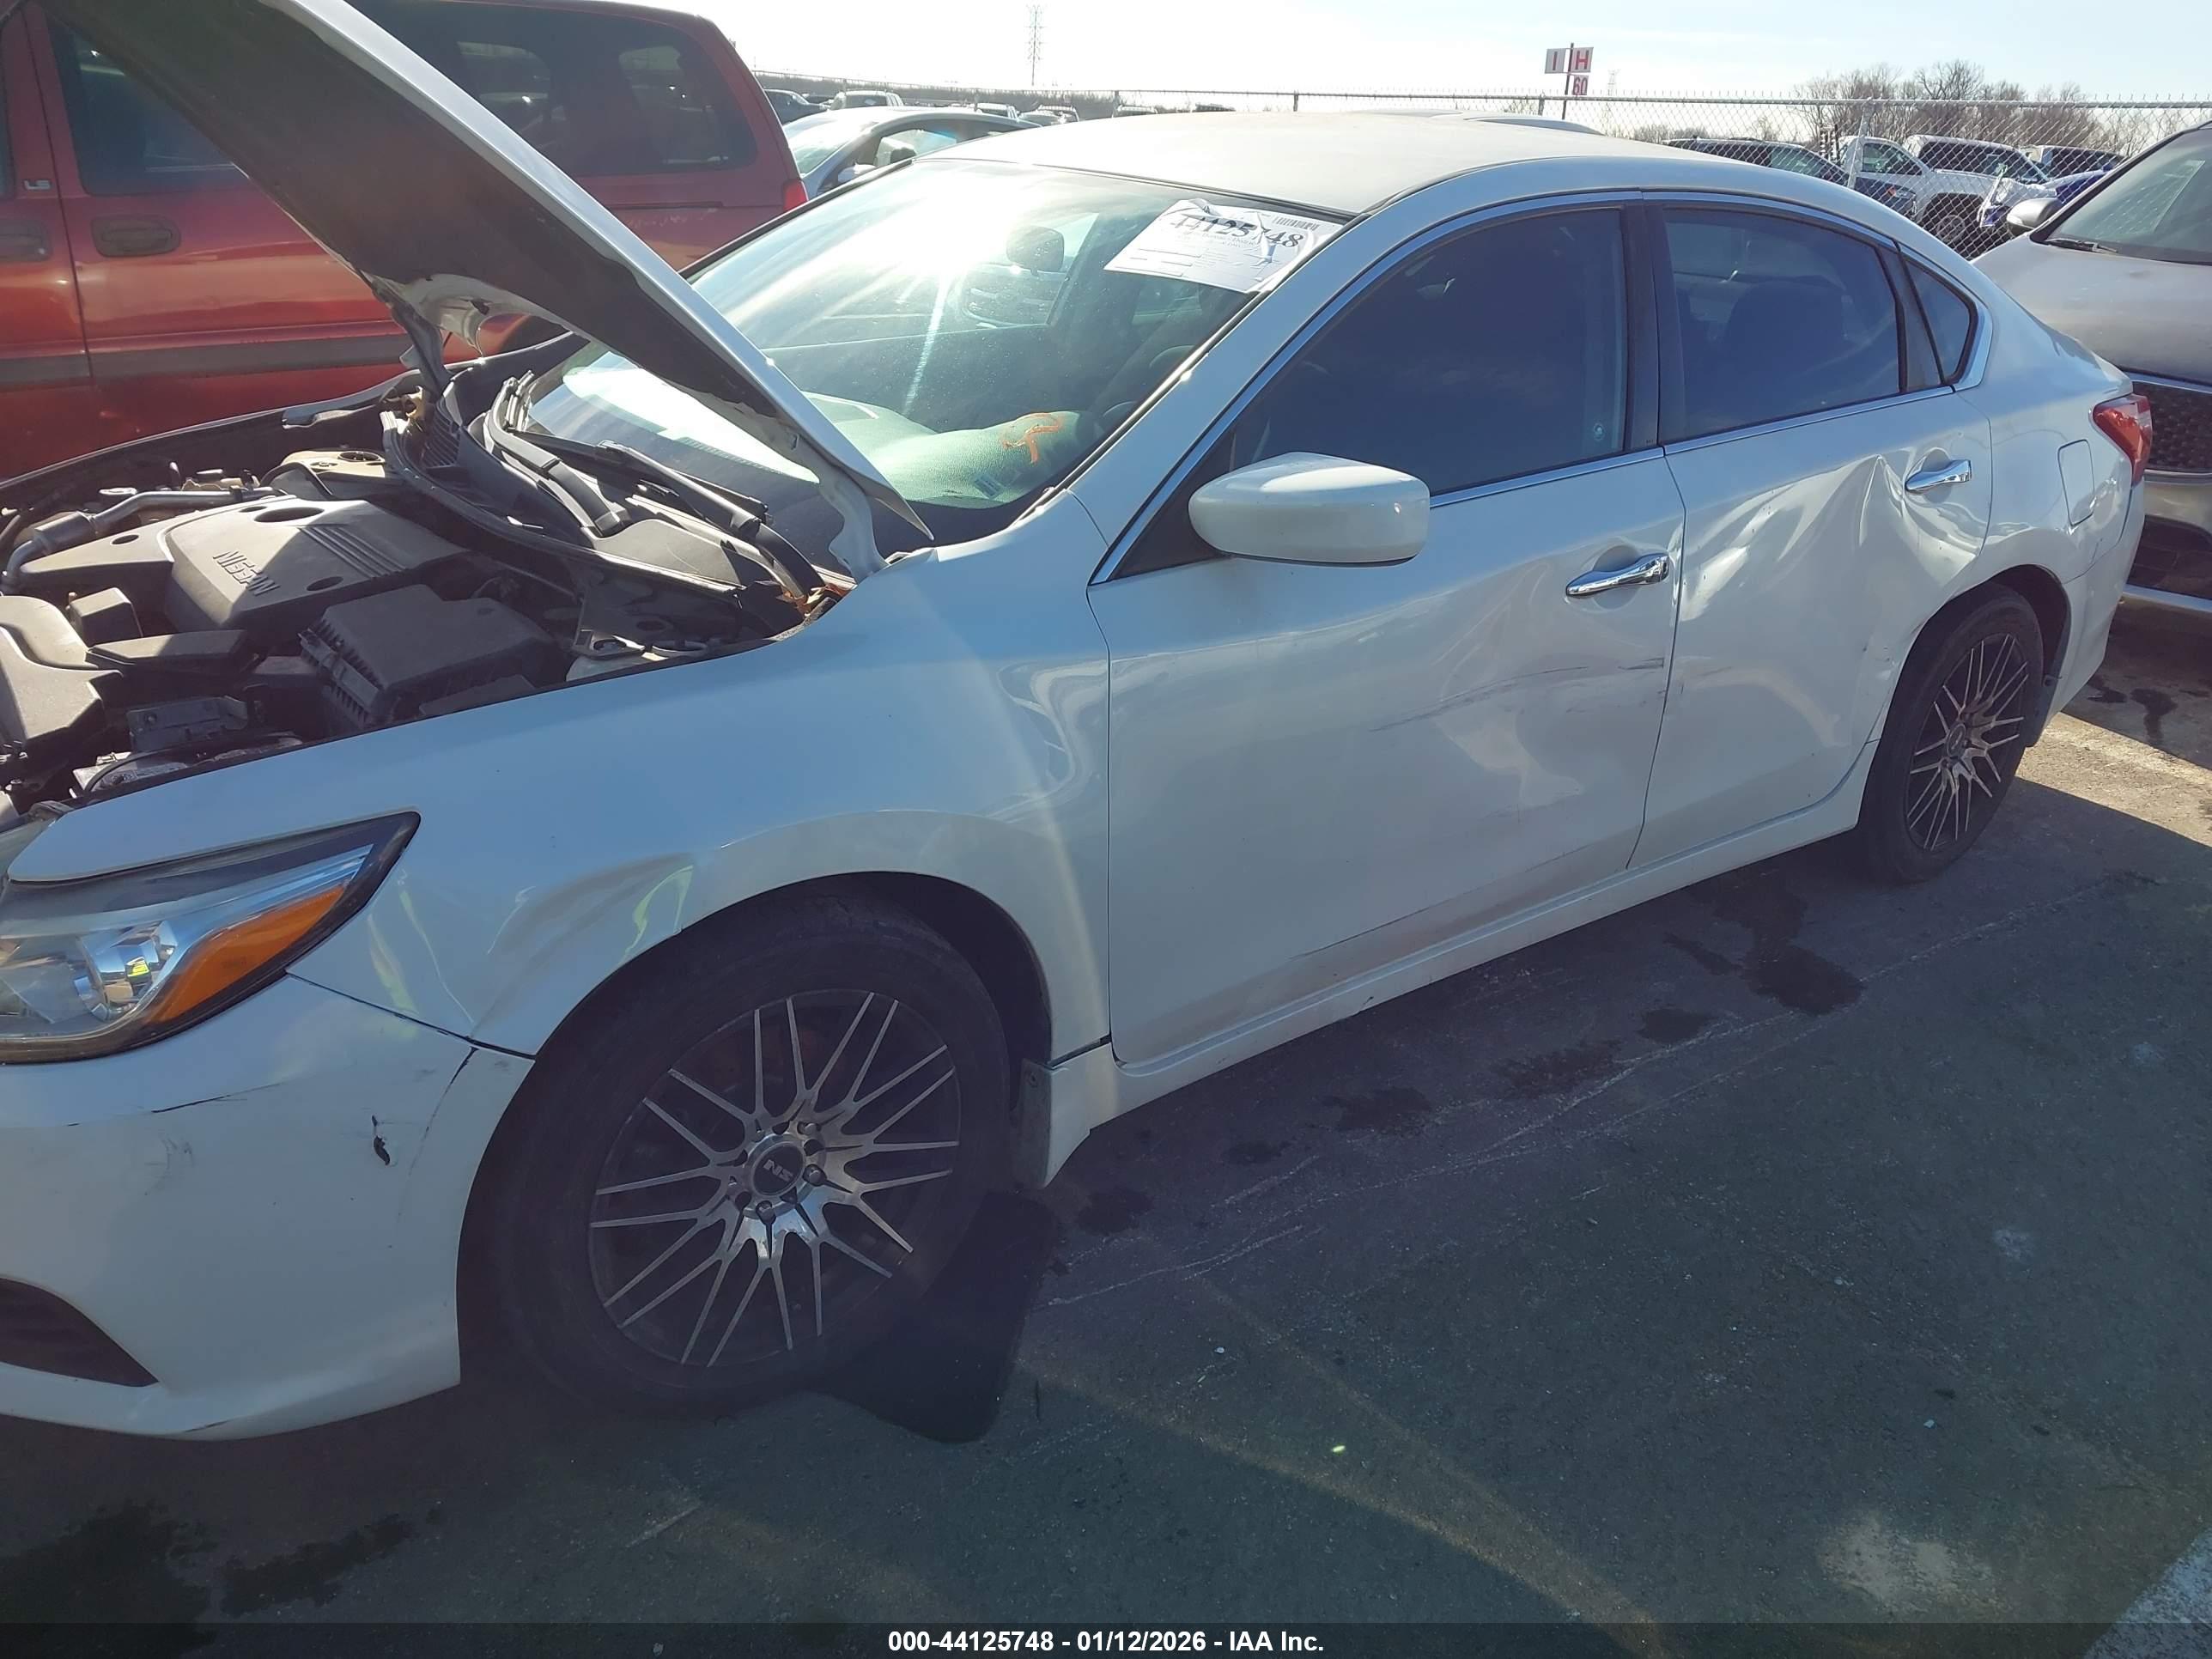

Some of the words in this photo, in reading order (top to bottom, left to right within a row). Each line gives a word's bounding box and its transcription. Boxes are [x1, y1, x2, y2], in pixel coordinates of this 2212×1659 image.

[1575, 50, 1589, 70] H
[1573, 76, 1589, 95] 60
[23, 179, 52, 191] LS
[1170, 216, 1304, 248] 4412548
[212, 550, 282, 597] NISSAN
